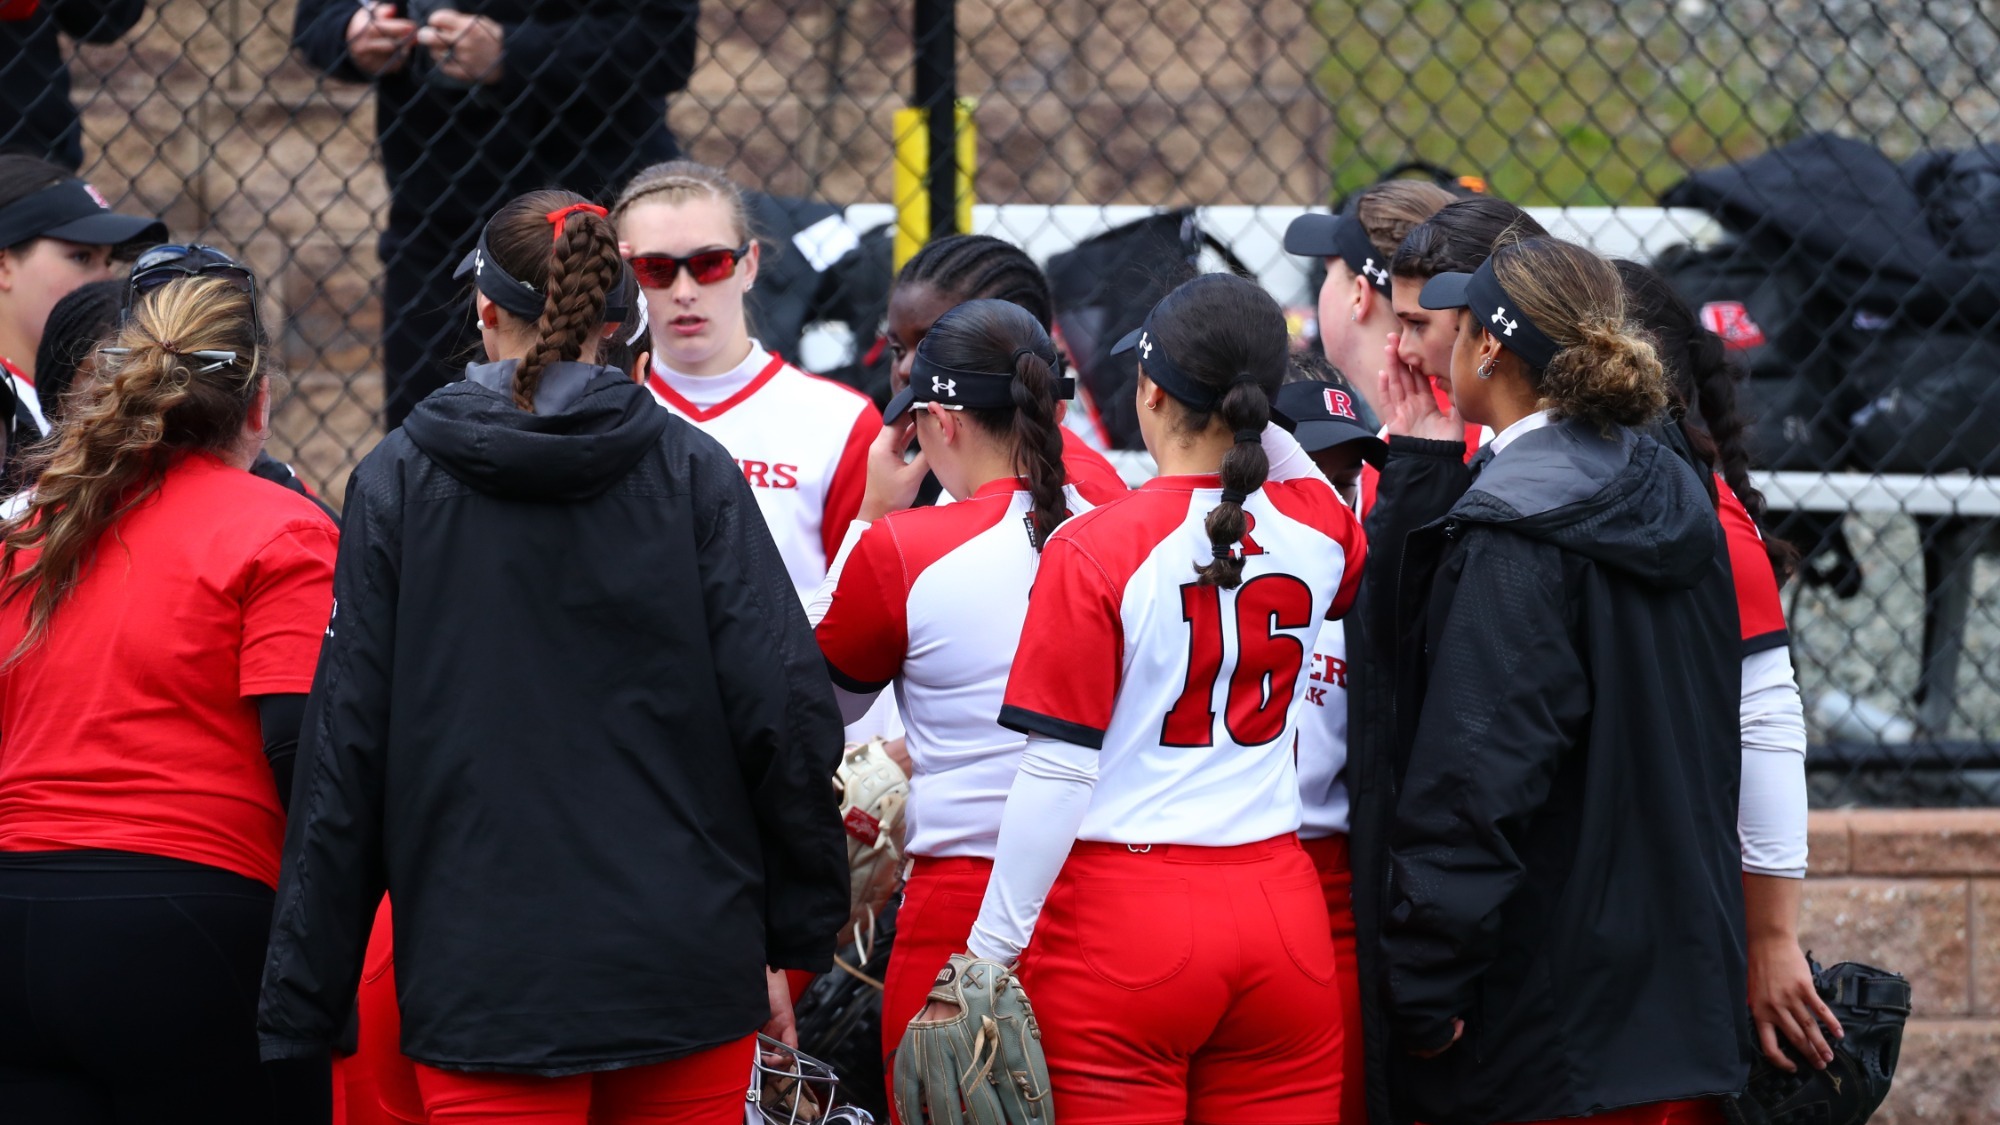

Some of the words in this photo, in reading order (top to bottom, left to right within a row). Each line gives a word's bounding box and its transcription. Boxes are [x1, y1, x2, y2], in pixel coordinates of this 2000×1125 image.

[1325, 388, 1357, 420] R
[733, 458, 798, 489] RS
[1159, 572, 1313, 748] 16
